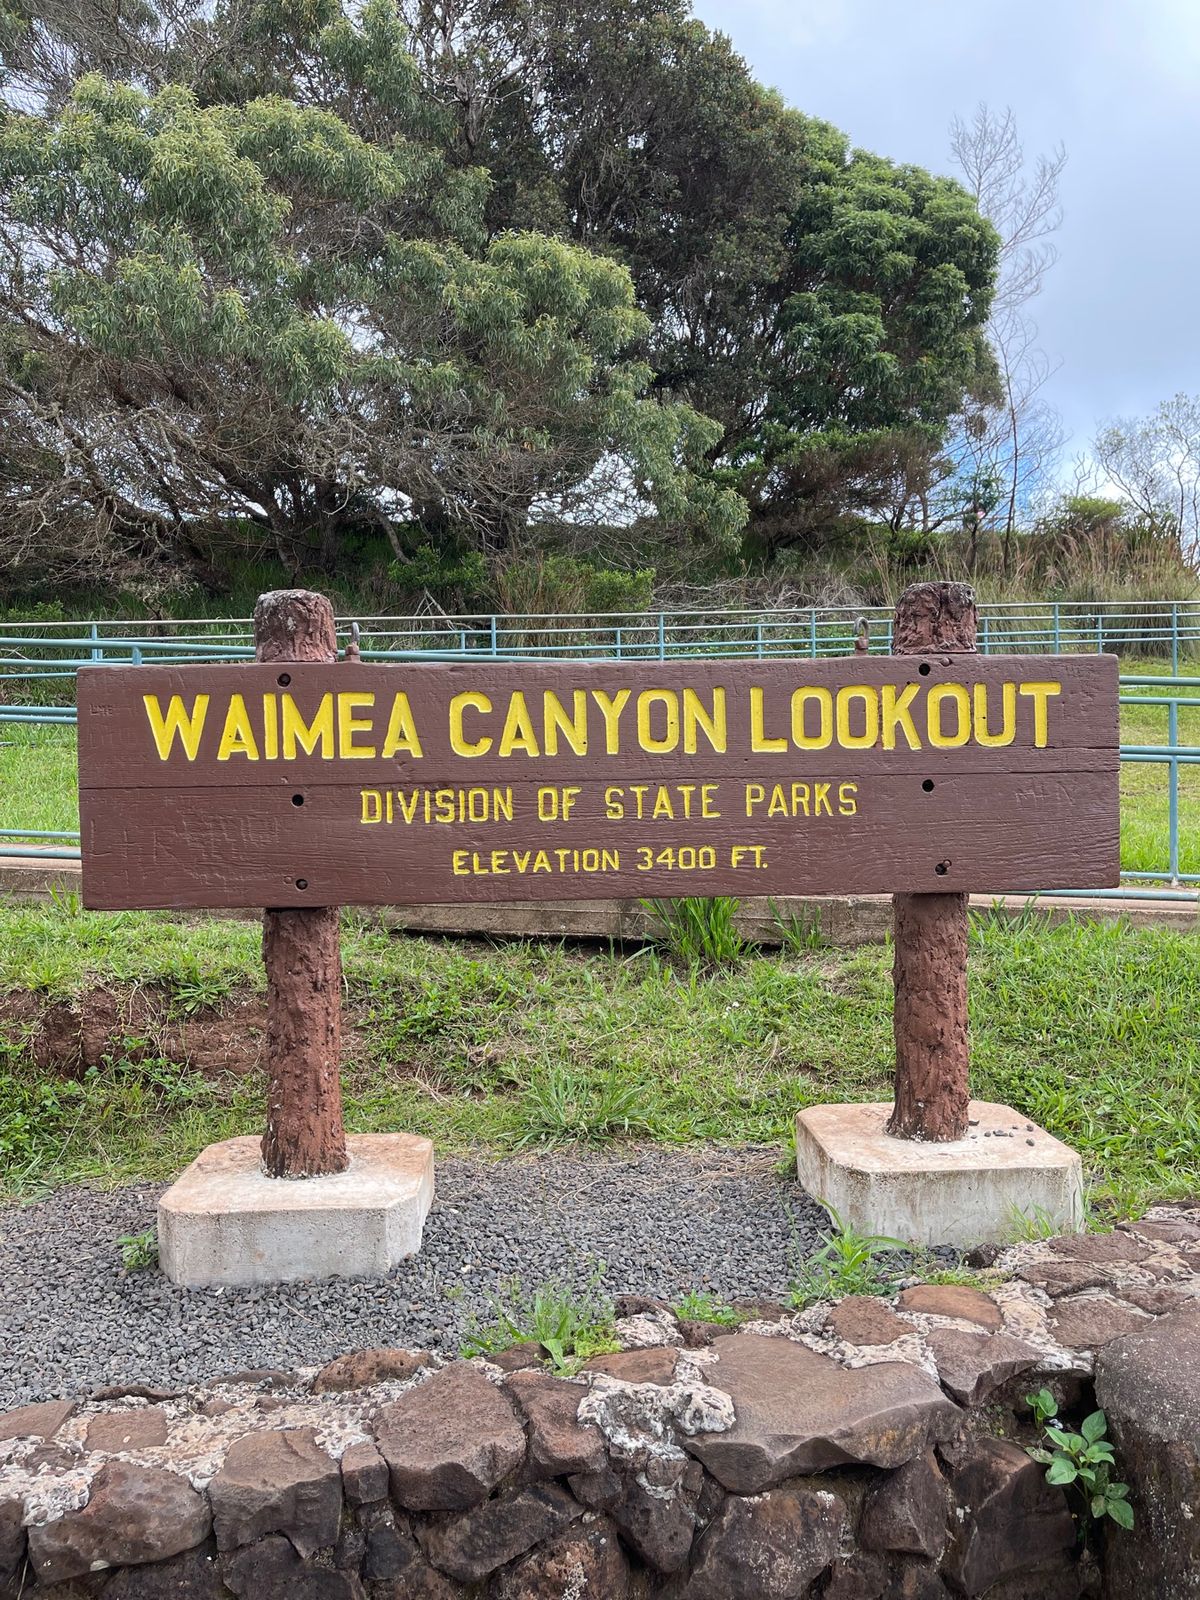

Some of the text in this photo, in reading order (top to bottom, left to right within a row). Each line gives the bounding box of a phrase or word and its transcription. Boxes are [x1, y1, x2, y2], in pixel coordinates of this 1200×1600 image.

[143, 681, 1062, 762] WAIMEA CANYON LOOKOUT
[360, 781, 859, 825] DIVISION OF STATE PARKS
[452, 843, 769, 876] ELEVATION 3400 FT.
